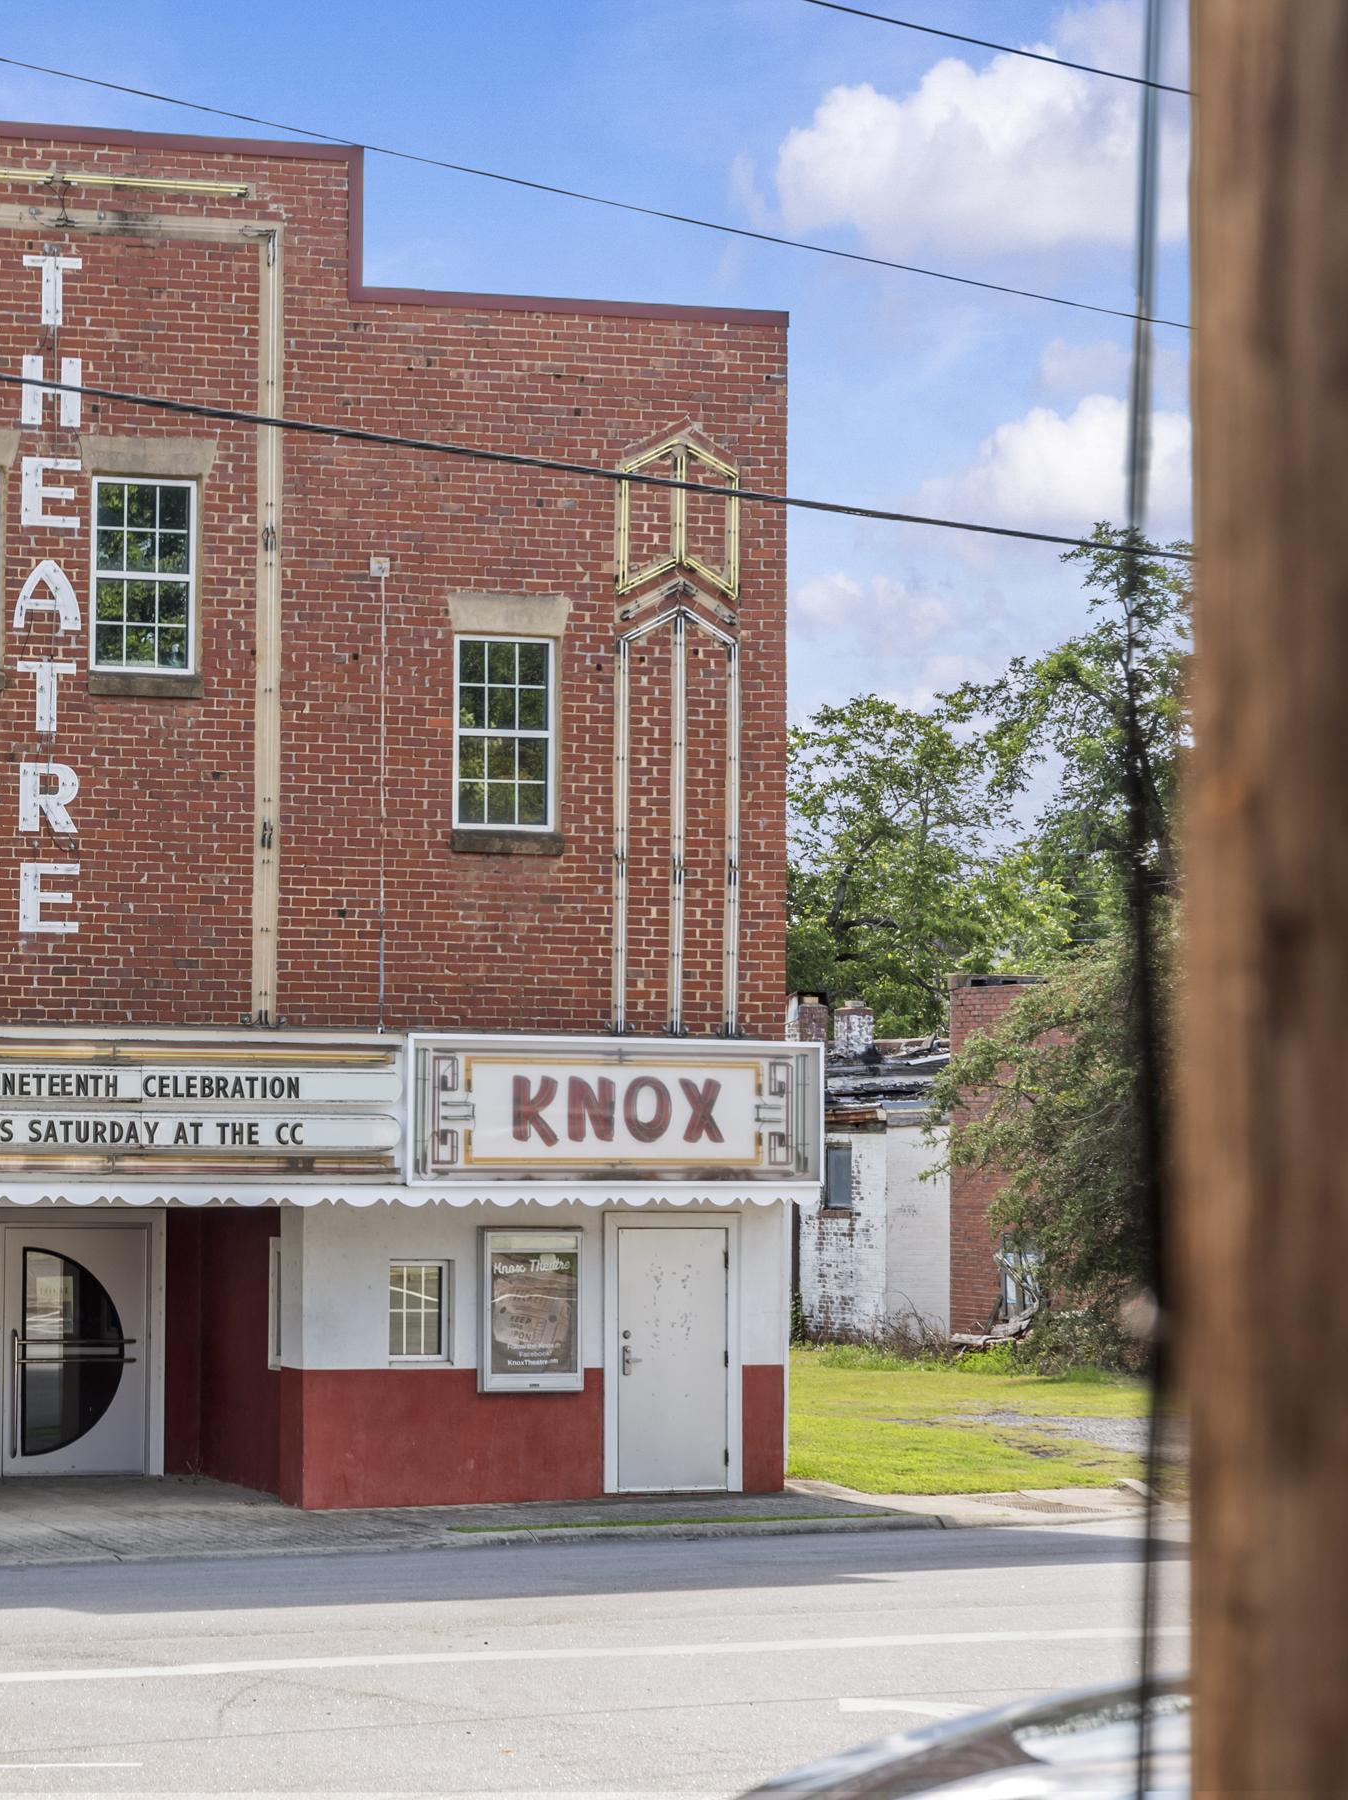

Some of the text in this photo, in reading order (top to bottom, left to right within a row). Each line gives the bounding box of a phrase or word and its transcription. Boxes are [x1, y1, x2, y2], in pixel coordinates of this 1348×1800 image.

[13, 254, 83, 933] THEATRE
[142, 1074, 301, 1099] CELEBRATION
[512, 1074, 725, 1147] KNOX
[28, 1119, 160, 1145] SATURDAY
[174, 1122, 203, 1144] AT
[216, 1122, 260, 1145] THE
[275, 1122, 304, 1145] CC
[493, 1257, 571, 1275] Knox Theatre
